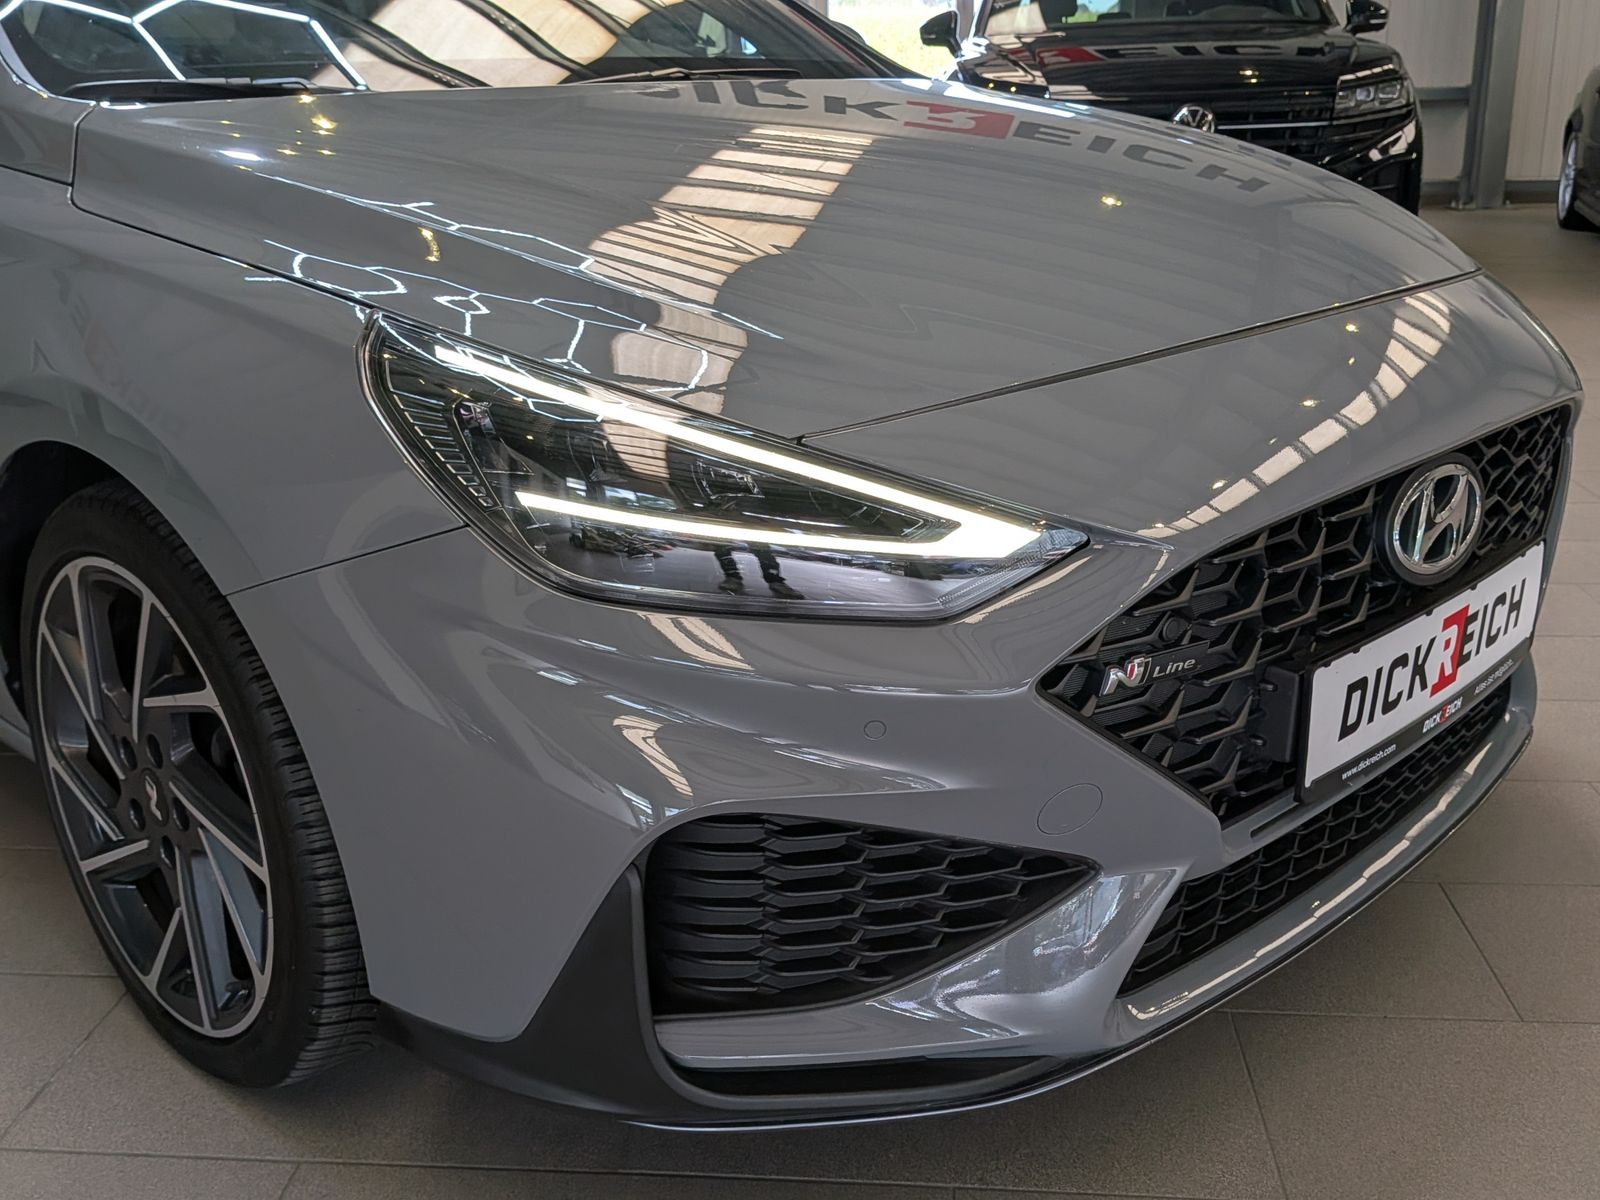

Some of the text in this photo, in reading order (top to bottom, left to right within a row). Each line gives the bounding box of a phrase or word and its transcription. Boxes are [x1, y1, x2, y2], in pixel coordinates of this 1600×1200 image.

[1153, 659, 1196, 678] Line
[1337, 577, 1527, 743] DICKREICH
[1422, 696, 1463, 733] DICKREICH
[1341, 743, 1397, 781] www.dickreich.com
